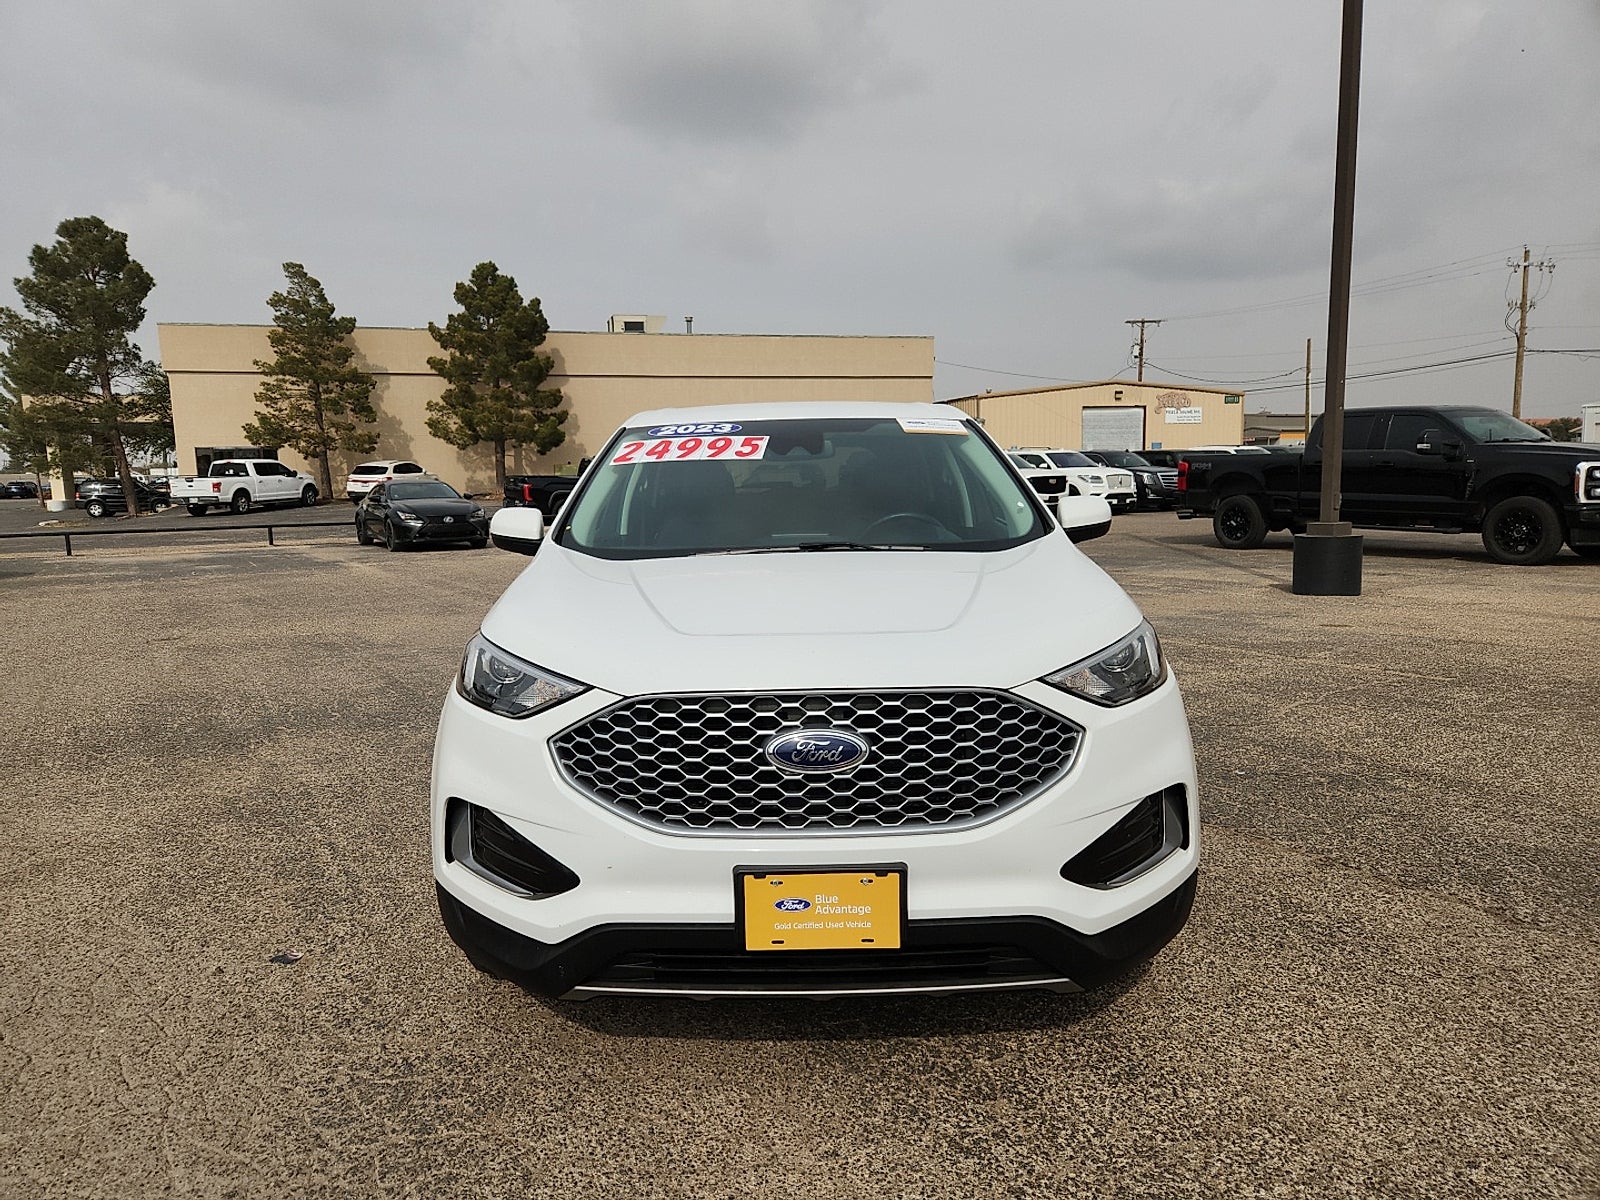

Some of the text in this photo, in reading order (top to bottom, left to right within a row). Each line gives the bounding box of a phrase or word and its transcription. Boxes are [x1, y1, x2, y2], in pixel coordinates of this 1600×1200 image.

[657, 424, 732, 435] 2023
[613, 437, 765, 463] 24995
[791, 740, 843, 762] Ford
[815, 894, 838, 904] Blue
[815, 904, 872, 915] Advantage
[774, 920, 872, 930] Gold Certified Used Vehicle
